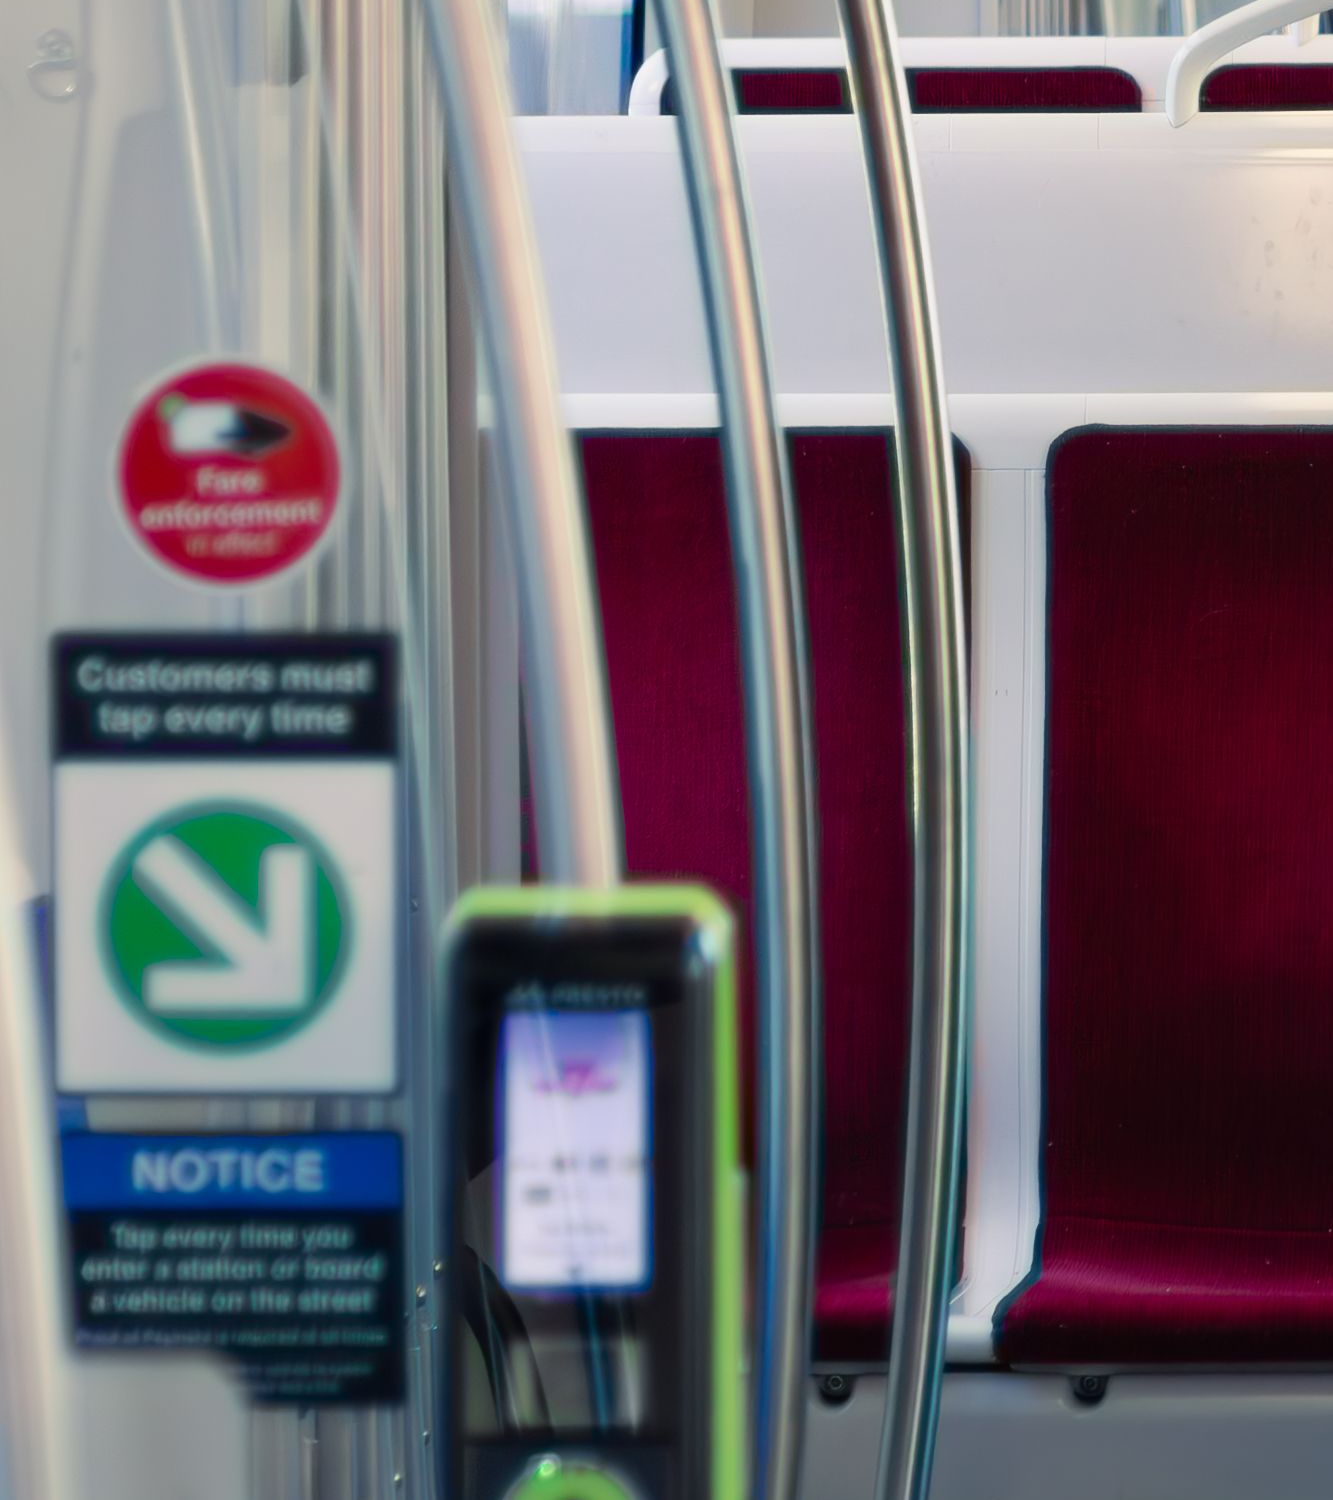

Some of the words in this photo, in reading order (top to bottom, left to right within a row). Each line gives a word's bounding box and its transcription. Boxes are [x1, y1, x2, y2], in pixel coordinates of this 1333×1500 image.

[196, 466, 262, 496] Fare
[139, 501, 319, 530] enforcement
[78, 657, 275, 693] Customers
[281, 661, 372, 693] must
[99, 702, 154, 741] tap
[164, 706, 263, 741] every
[271, 701, 350, 734] time
[132, 1151, 326, 1193] NOTICE
[111, 1222, 156, 1253] Tap
[163, 1226, 230, 1255] every
[240, 1222, 294, 1249] time
[302, 1227, 350, 1255] you
[80, 1257, 147, 1282] enter
[154, 1262, 170, 1282] a
[177, 1257, 264, 1282] station
[270, 1261, 299, 1282] or
[304, 1255, 384, 1282] board
[91, 1294, 106, 1314] a
[112, 1288, 204, 1314] vehicle
[211, 1294, 243, 1314] on
[251, 1288, 290, 1314] the
[298, 1288, 374, 1314] street
